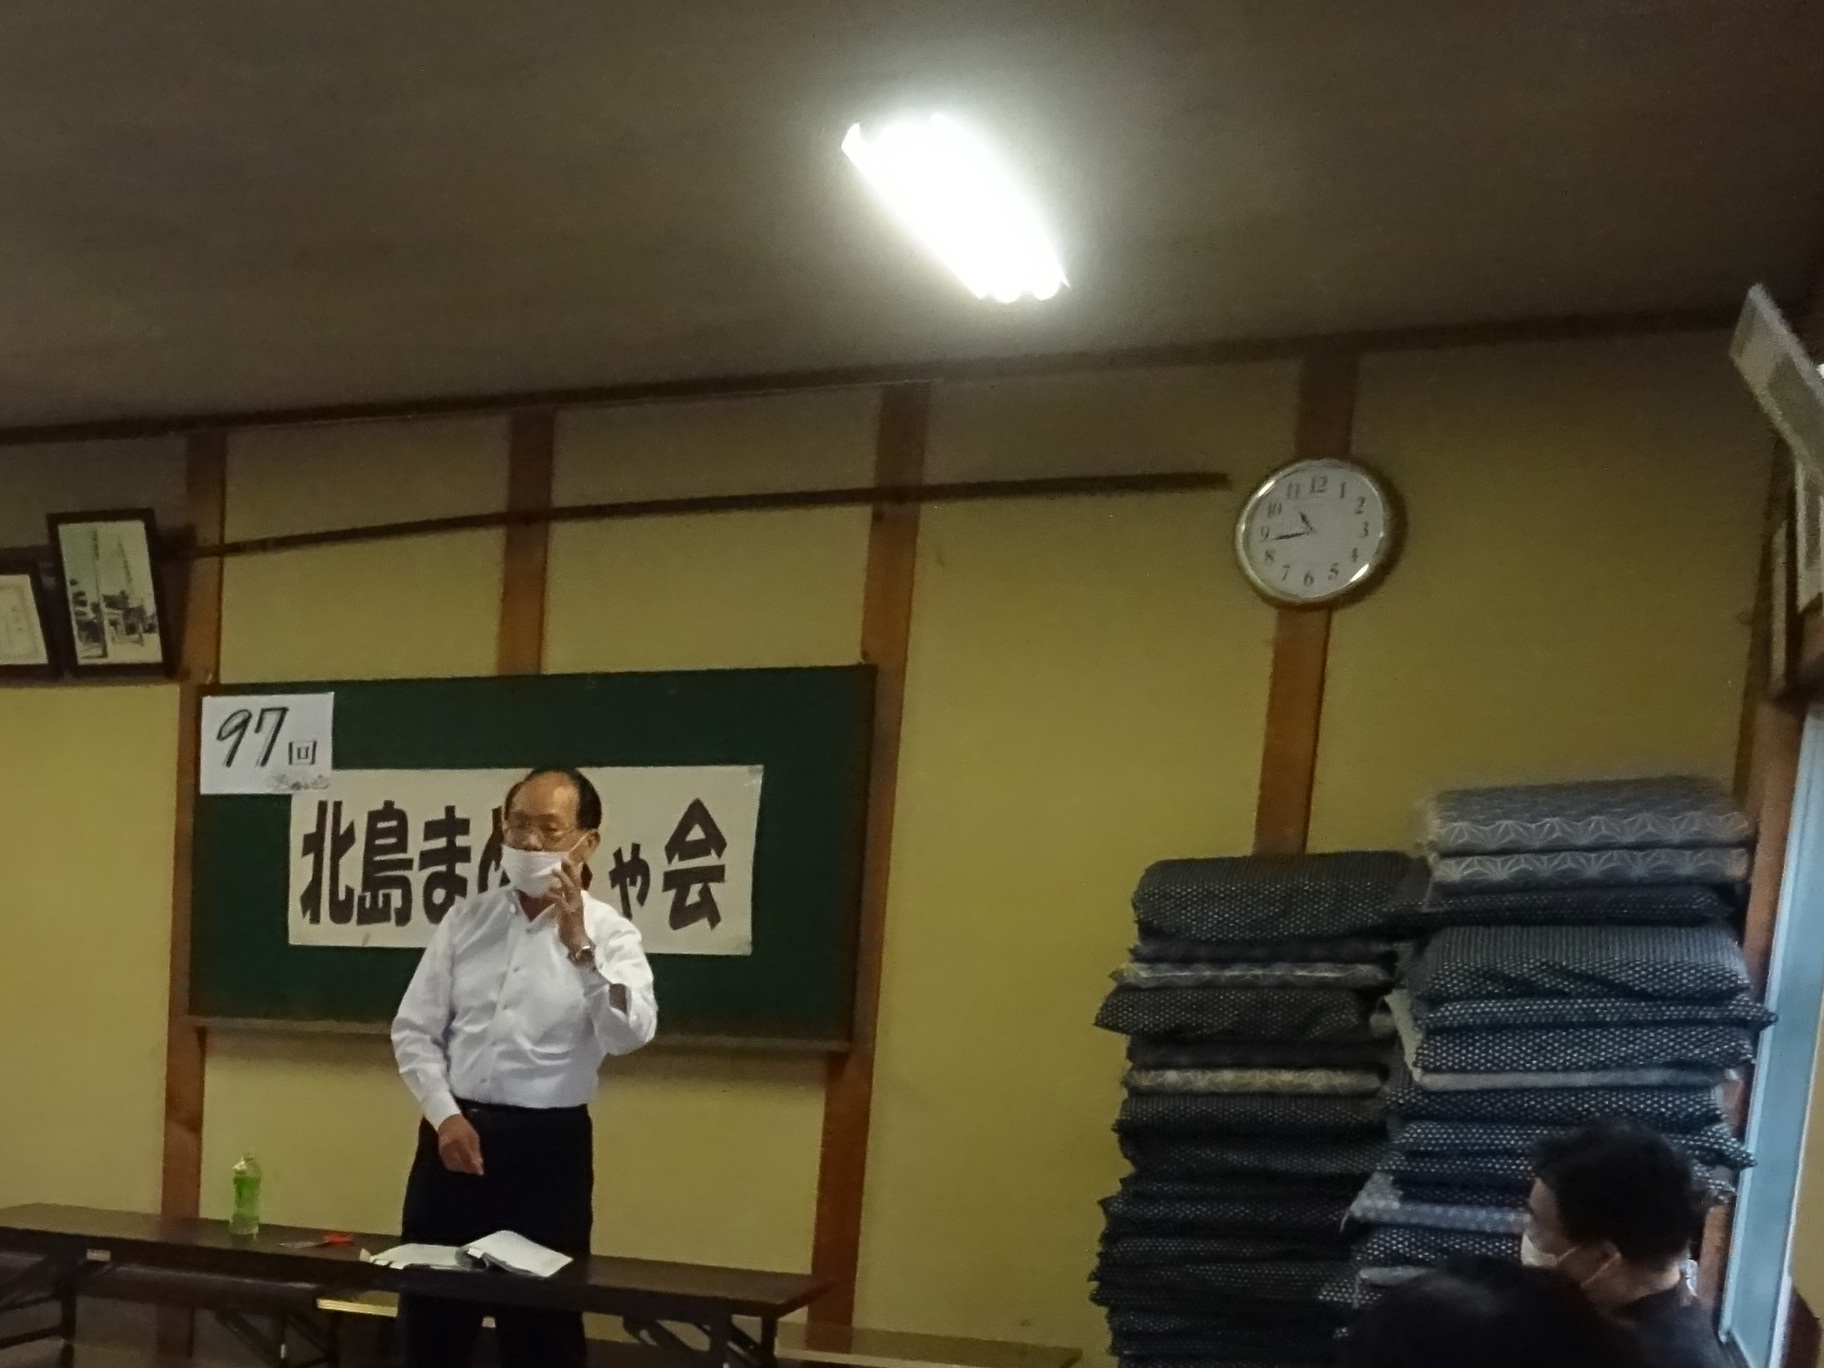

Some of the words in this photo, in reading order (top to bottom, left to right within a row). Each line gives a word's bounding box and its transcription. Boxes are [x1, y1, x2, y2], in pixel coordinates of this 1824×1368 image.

[1287, 481, 1301, 499] 11
[1309, 475, 1328, 494] 12
[1339, 481, 1346, 499] 1
[1267, 501, 1283, 518] 10
[1354, 496, 1366, 514] 2
[1260, 526, 1270, 541] 9
[1358, 521, 1369, 538] 3
[1264, 549, 1275, 562] 8
[1350, 547, 1359, 562] 4
[1282, 563, 1291, 581] 7
[1303, 569, 1314, 587] 6
[1327, 562, 1339, 580] 5
[216, 706, 317, 768] 97回
